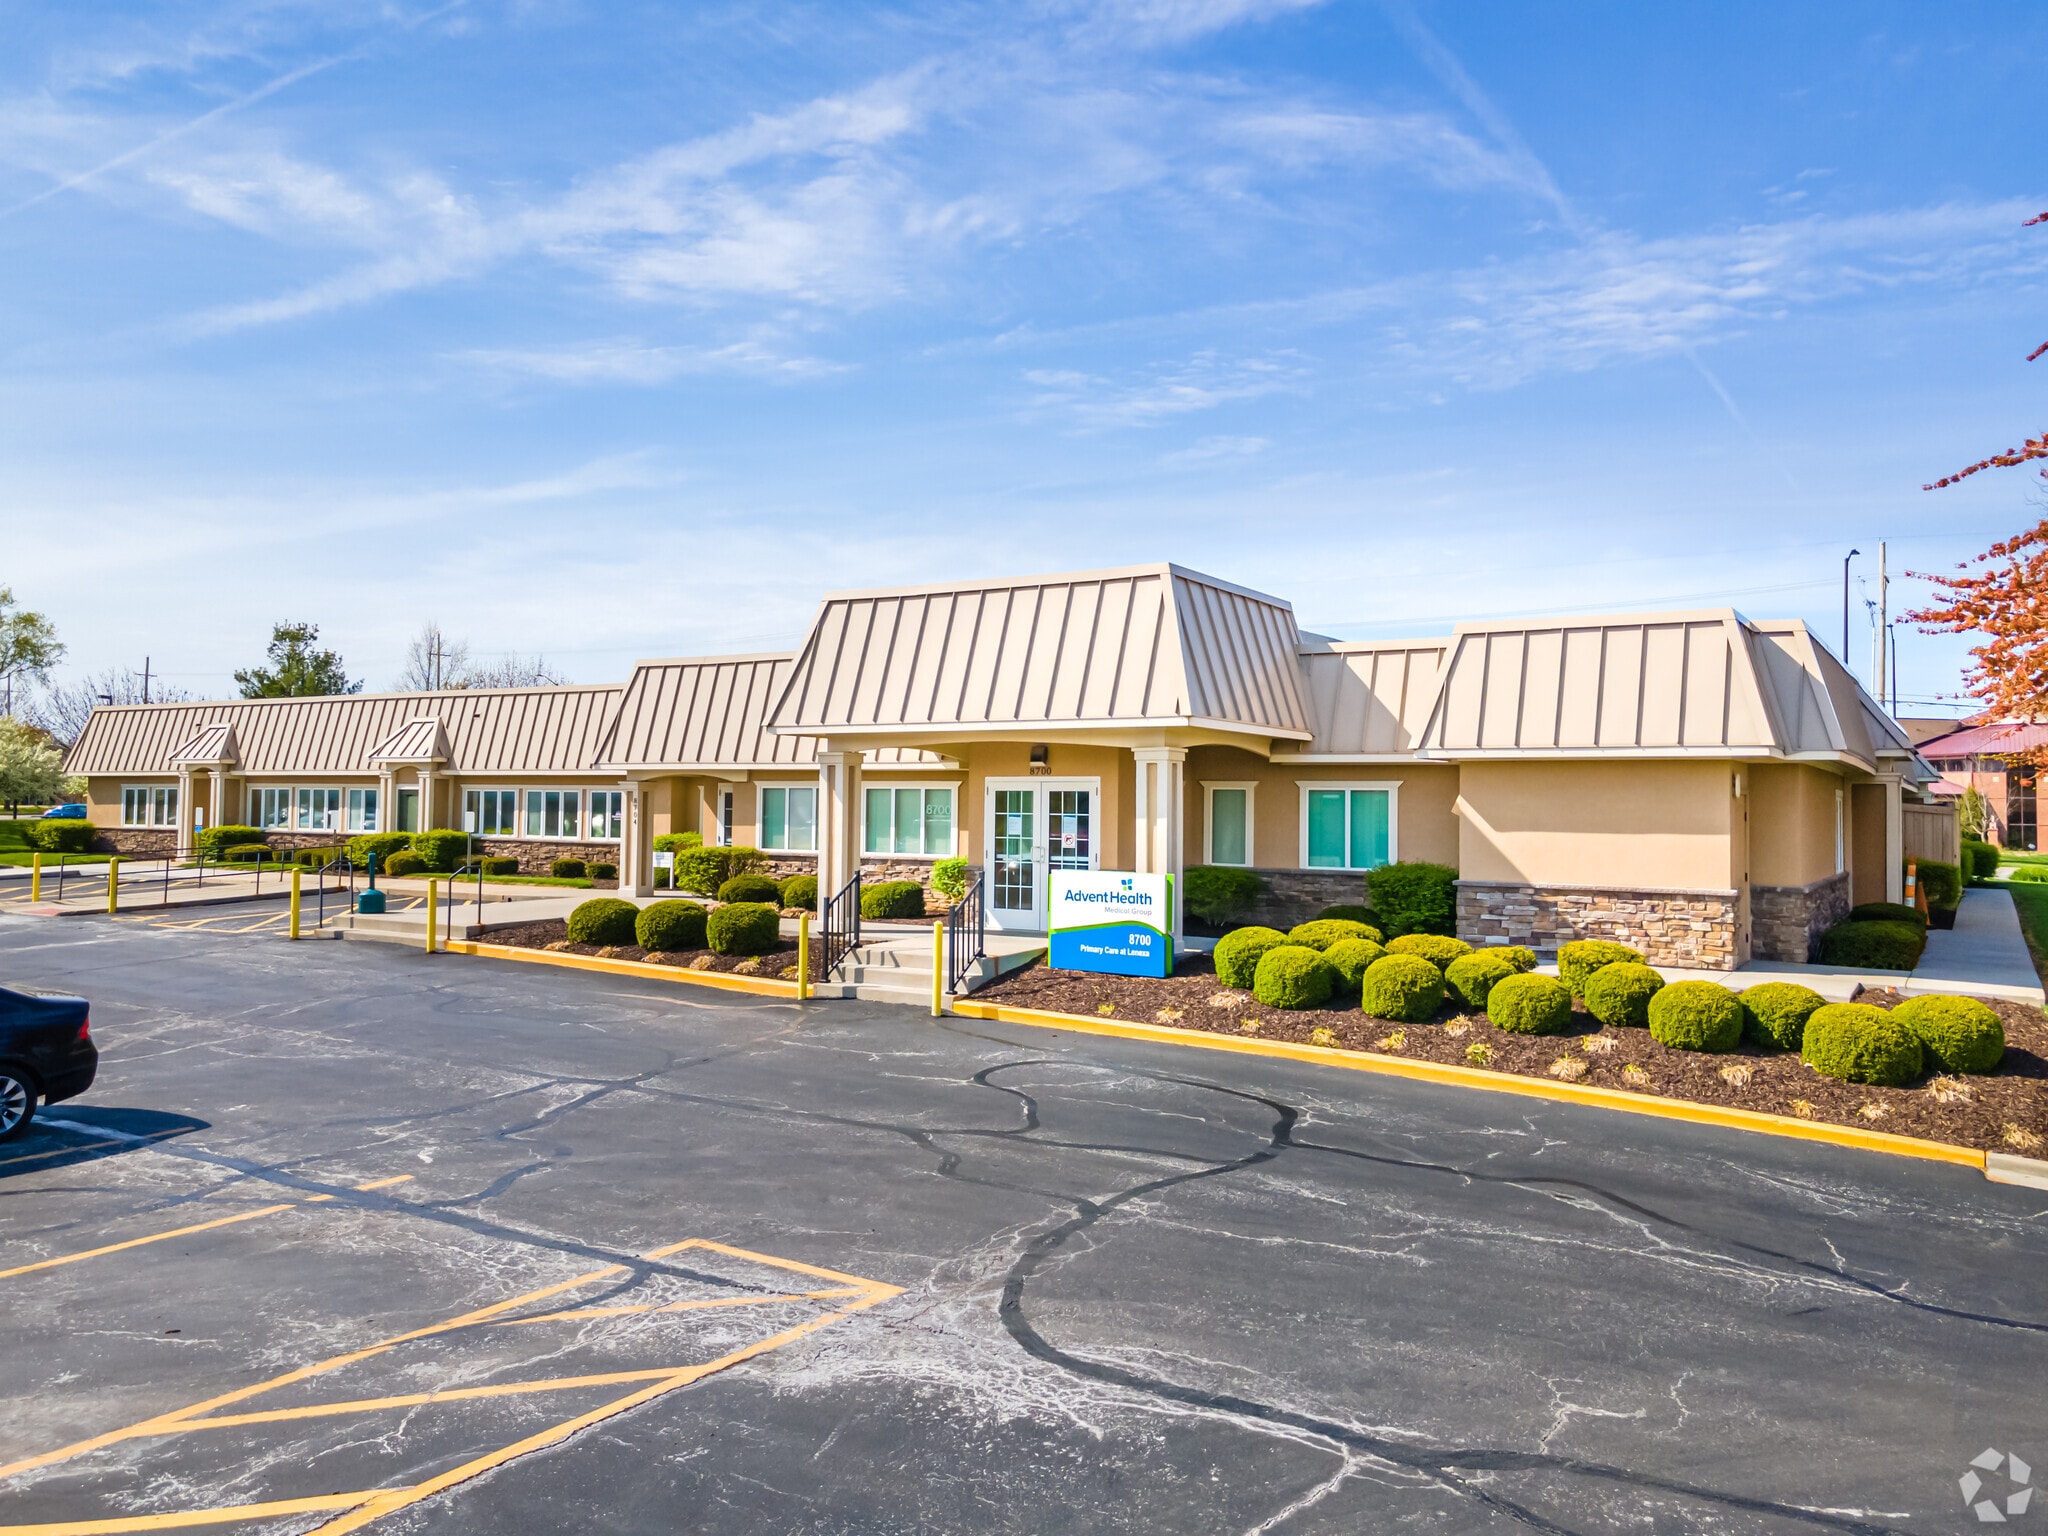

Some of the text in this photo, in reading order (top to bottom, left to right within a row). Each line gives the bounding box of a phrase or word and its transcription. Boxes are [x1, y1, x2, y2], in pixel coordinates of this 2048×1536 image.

[1029, 767, 1052, 775] 8700
[926, 805, 951, 815] 8700
[1104, 906, 1152, 916] Medical Group
[1128, 933, 1152, 946] 8700
[1080, 944, 1104, 955] Primary
[1104, 946, 1119, 955] Care
